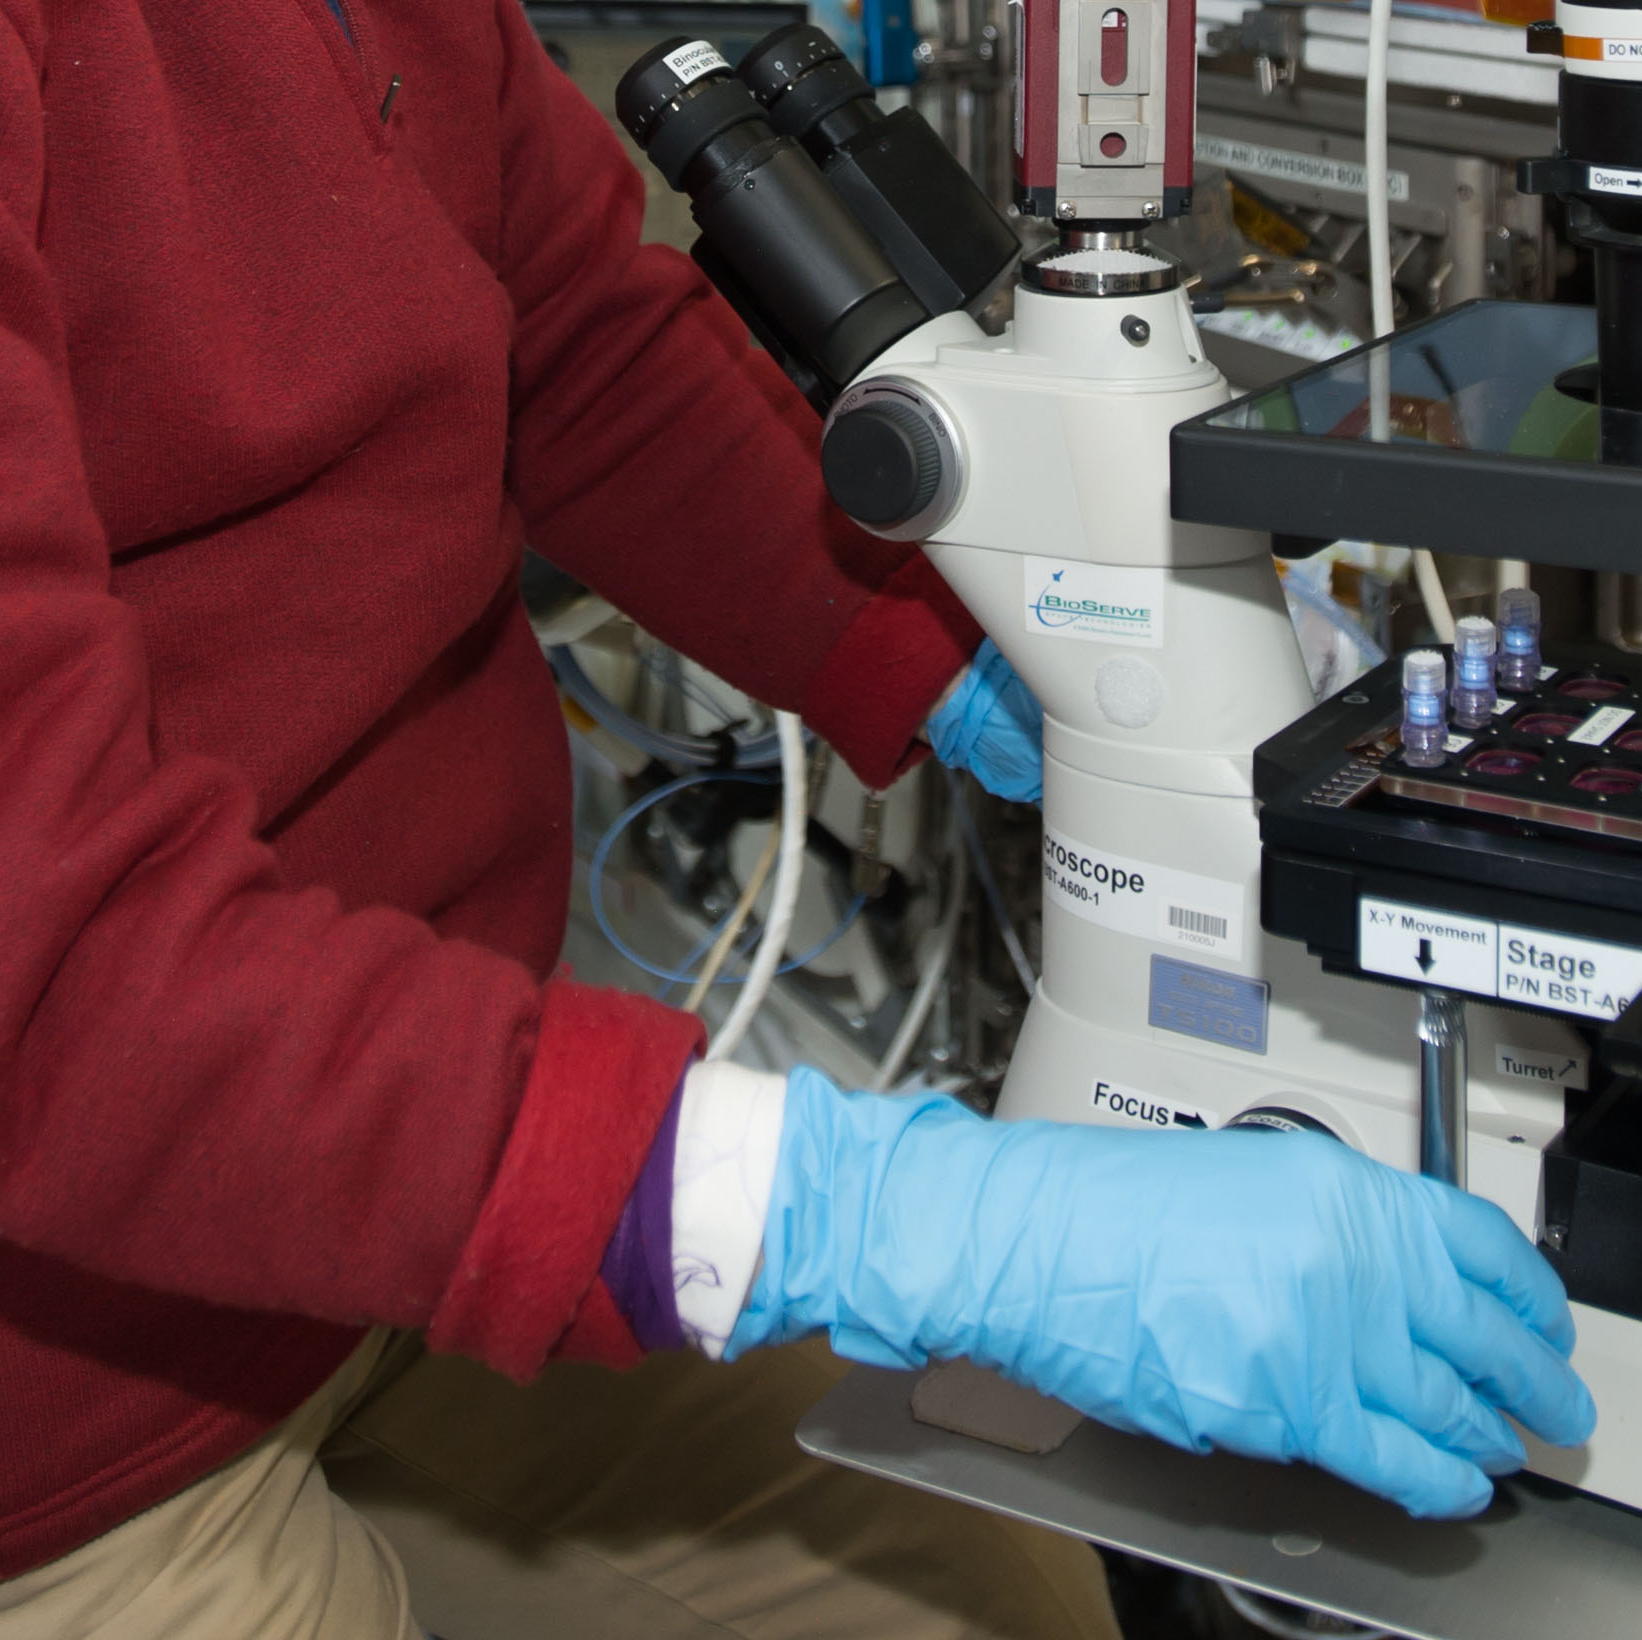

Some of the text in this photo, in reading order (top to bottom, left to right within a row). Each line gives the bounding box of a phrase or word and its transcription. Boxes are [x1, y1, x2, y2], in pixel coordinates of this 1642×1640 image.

[1608, 43, 1627, 56] DO
[682, 62, 702, 78] P/N
[1594, 172, 1624, 187] Open
[1059, 277, 1149, 290] MADE IN CHINA
[928, 412, 947, 439] BINO
[1368, 909, 1488, 946] X-Y Movement
[1507, 938, 1596, 981] Stage
[1506, 973, 1540, 997] P/N
[1502, 1056, 1556, 1081] Turret
[1093, 1081, 1170, 1126] Focus
[1246, 1114, 1298, 1132] Coar
